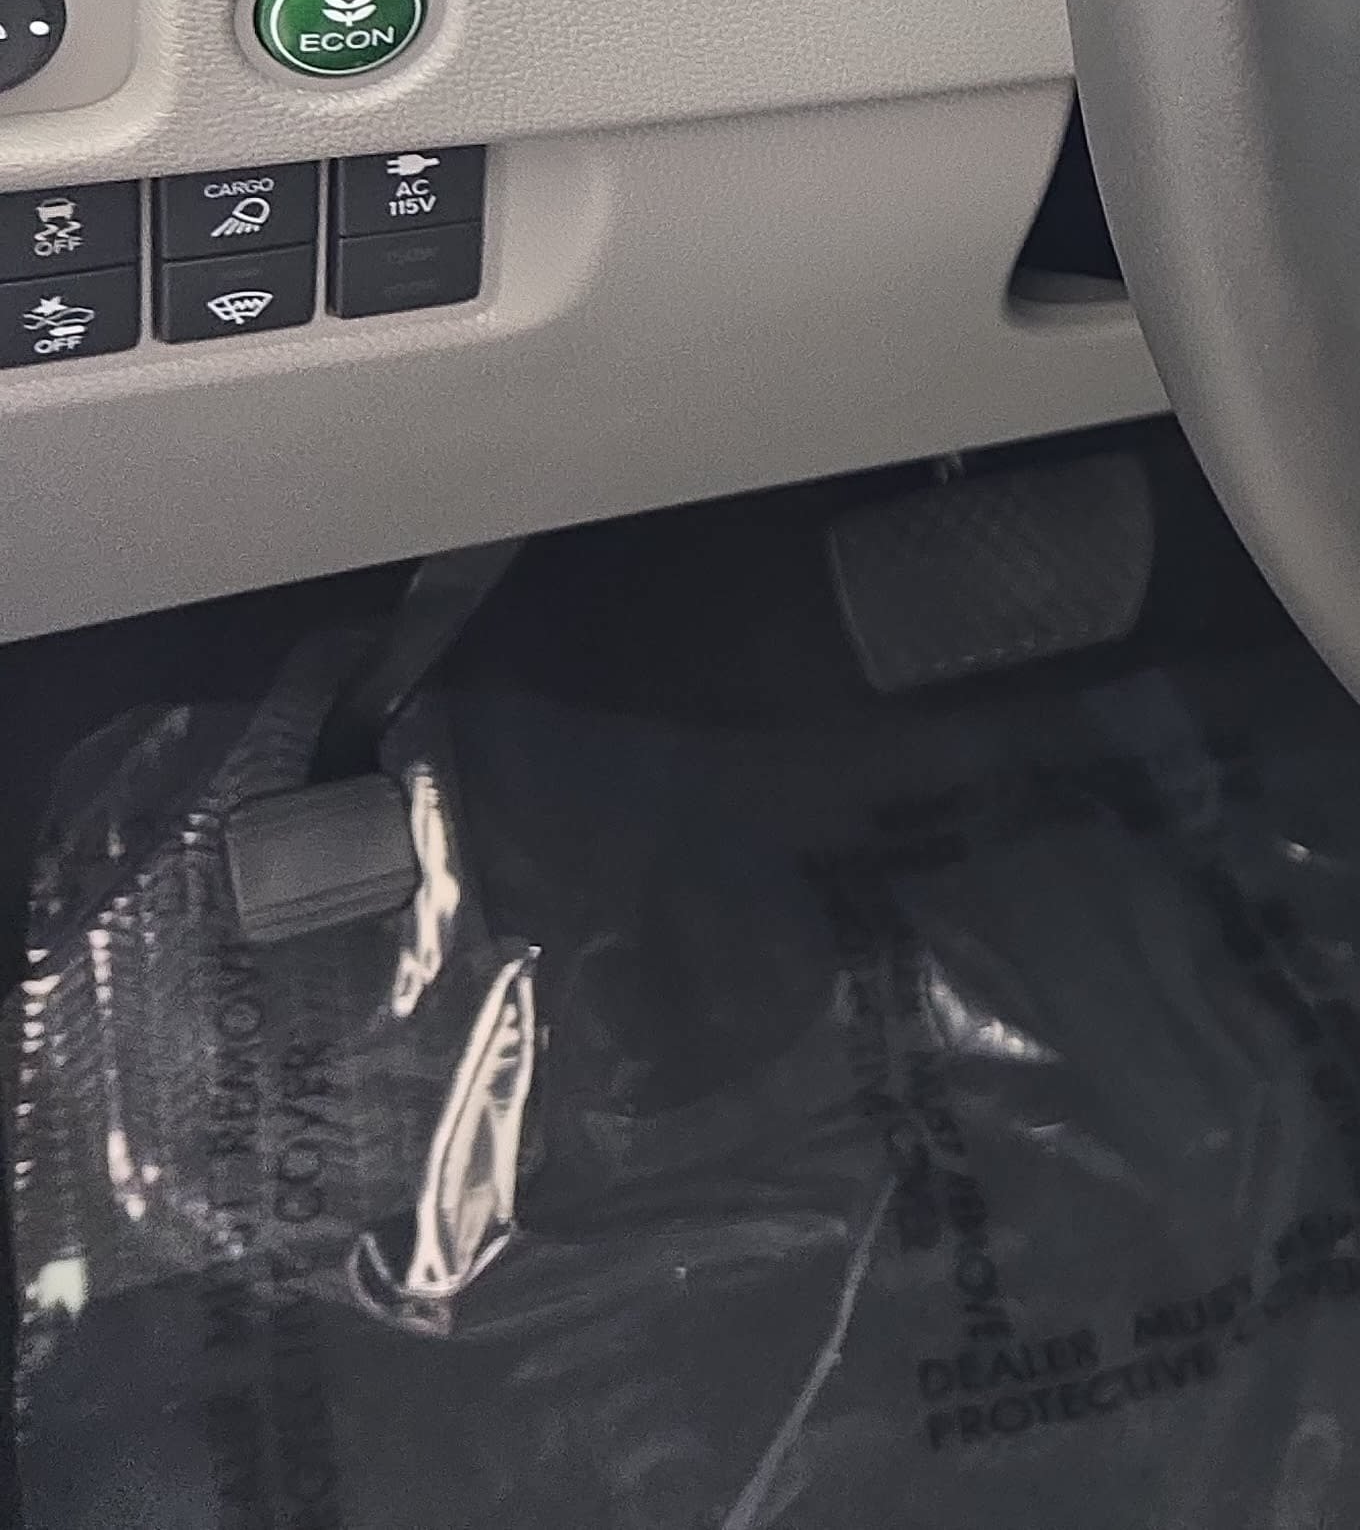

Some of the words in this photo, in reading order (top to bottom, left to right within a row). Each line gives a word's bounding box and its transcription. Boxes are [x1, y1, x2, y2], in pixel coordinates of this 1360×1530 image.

[300, 25, 395, 54] ECON
[203, 177, 275, 199] CARGO
[396, 178, 431, 198] AC
[388, 195, 437, 217] 115V
[34, 236, 85, 257] OFF
[34, 335, 83, 354] OFF
